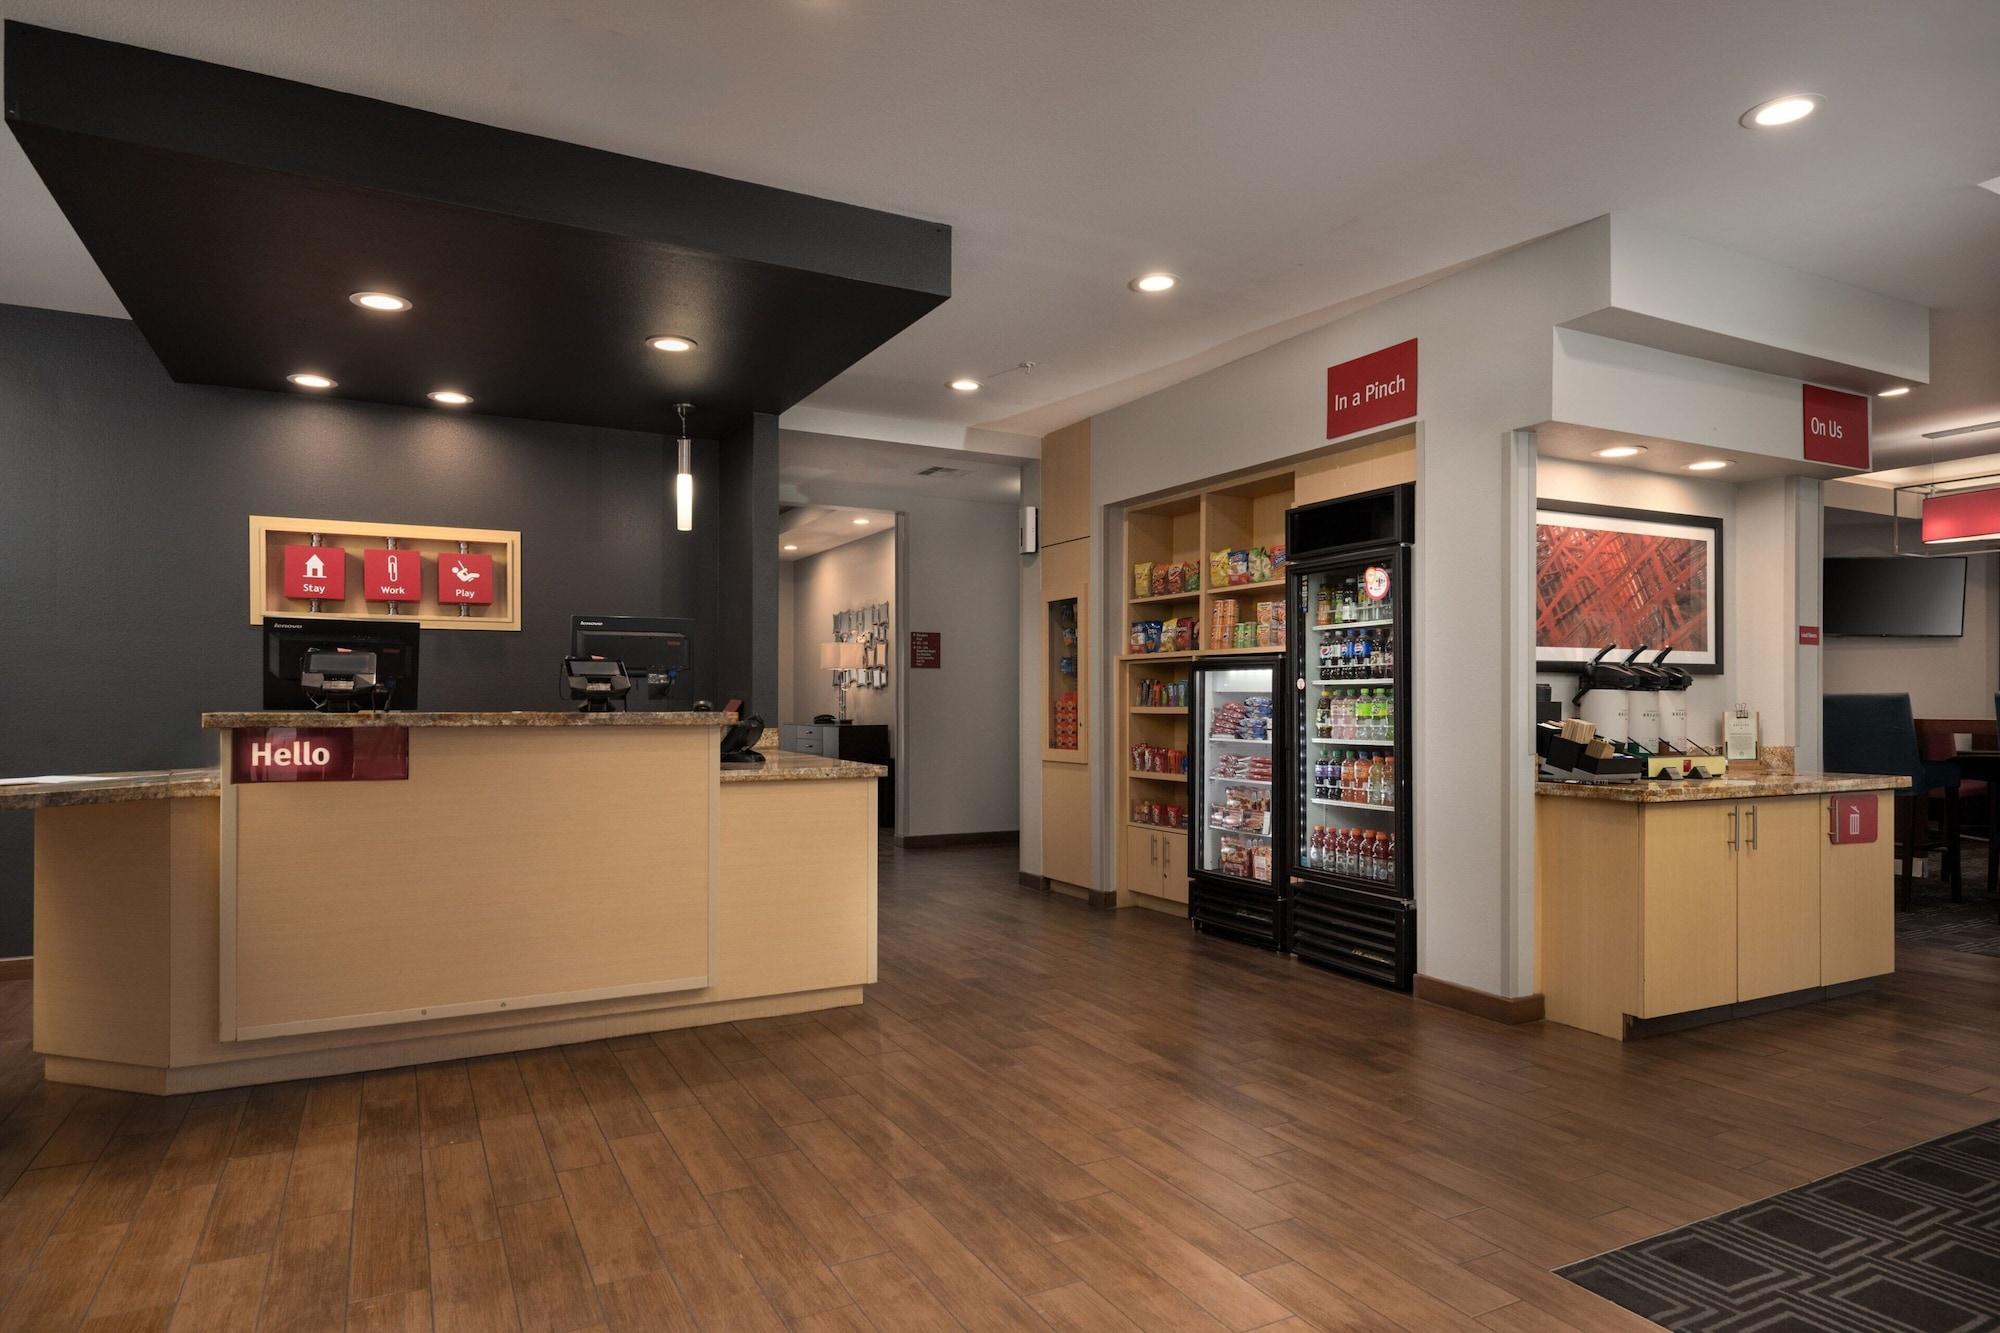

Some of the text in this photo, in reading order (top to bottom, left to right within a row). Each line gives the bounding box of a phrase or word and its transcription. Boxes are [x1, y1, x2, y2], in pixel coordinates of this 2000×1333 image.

[1335, 374, 1405, 412] In a Pinch
[1810, 417, 1843, 439] On Us
[302, 583, 325, 595] Stay
[380, 585, 405, 596] Work
[455, 588, 475, 600] Play
[251, 741, 331, 767] Hello
